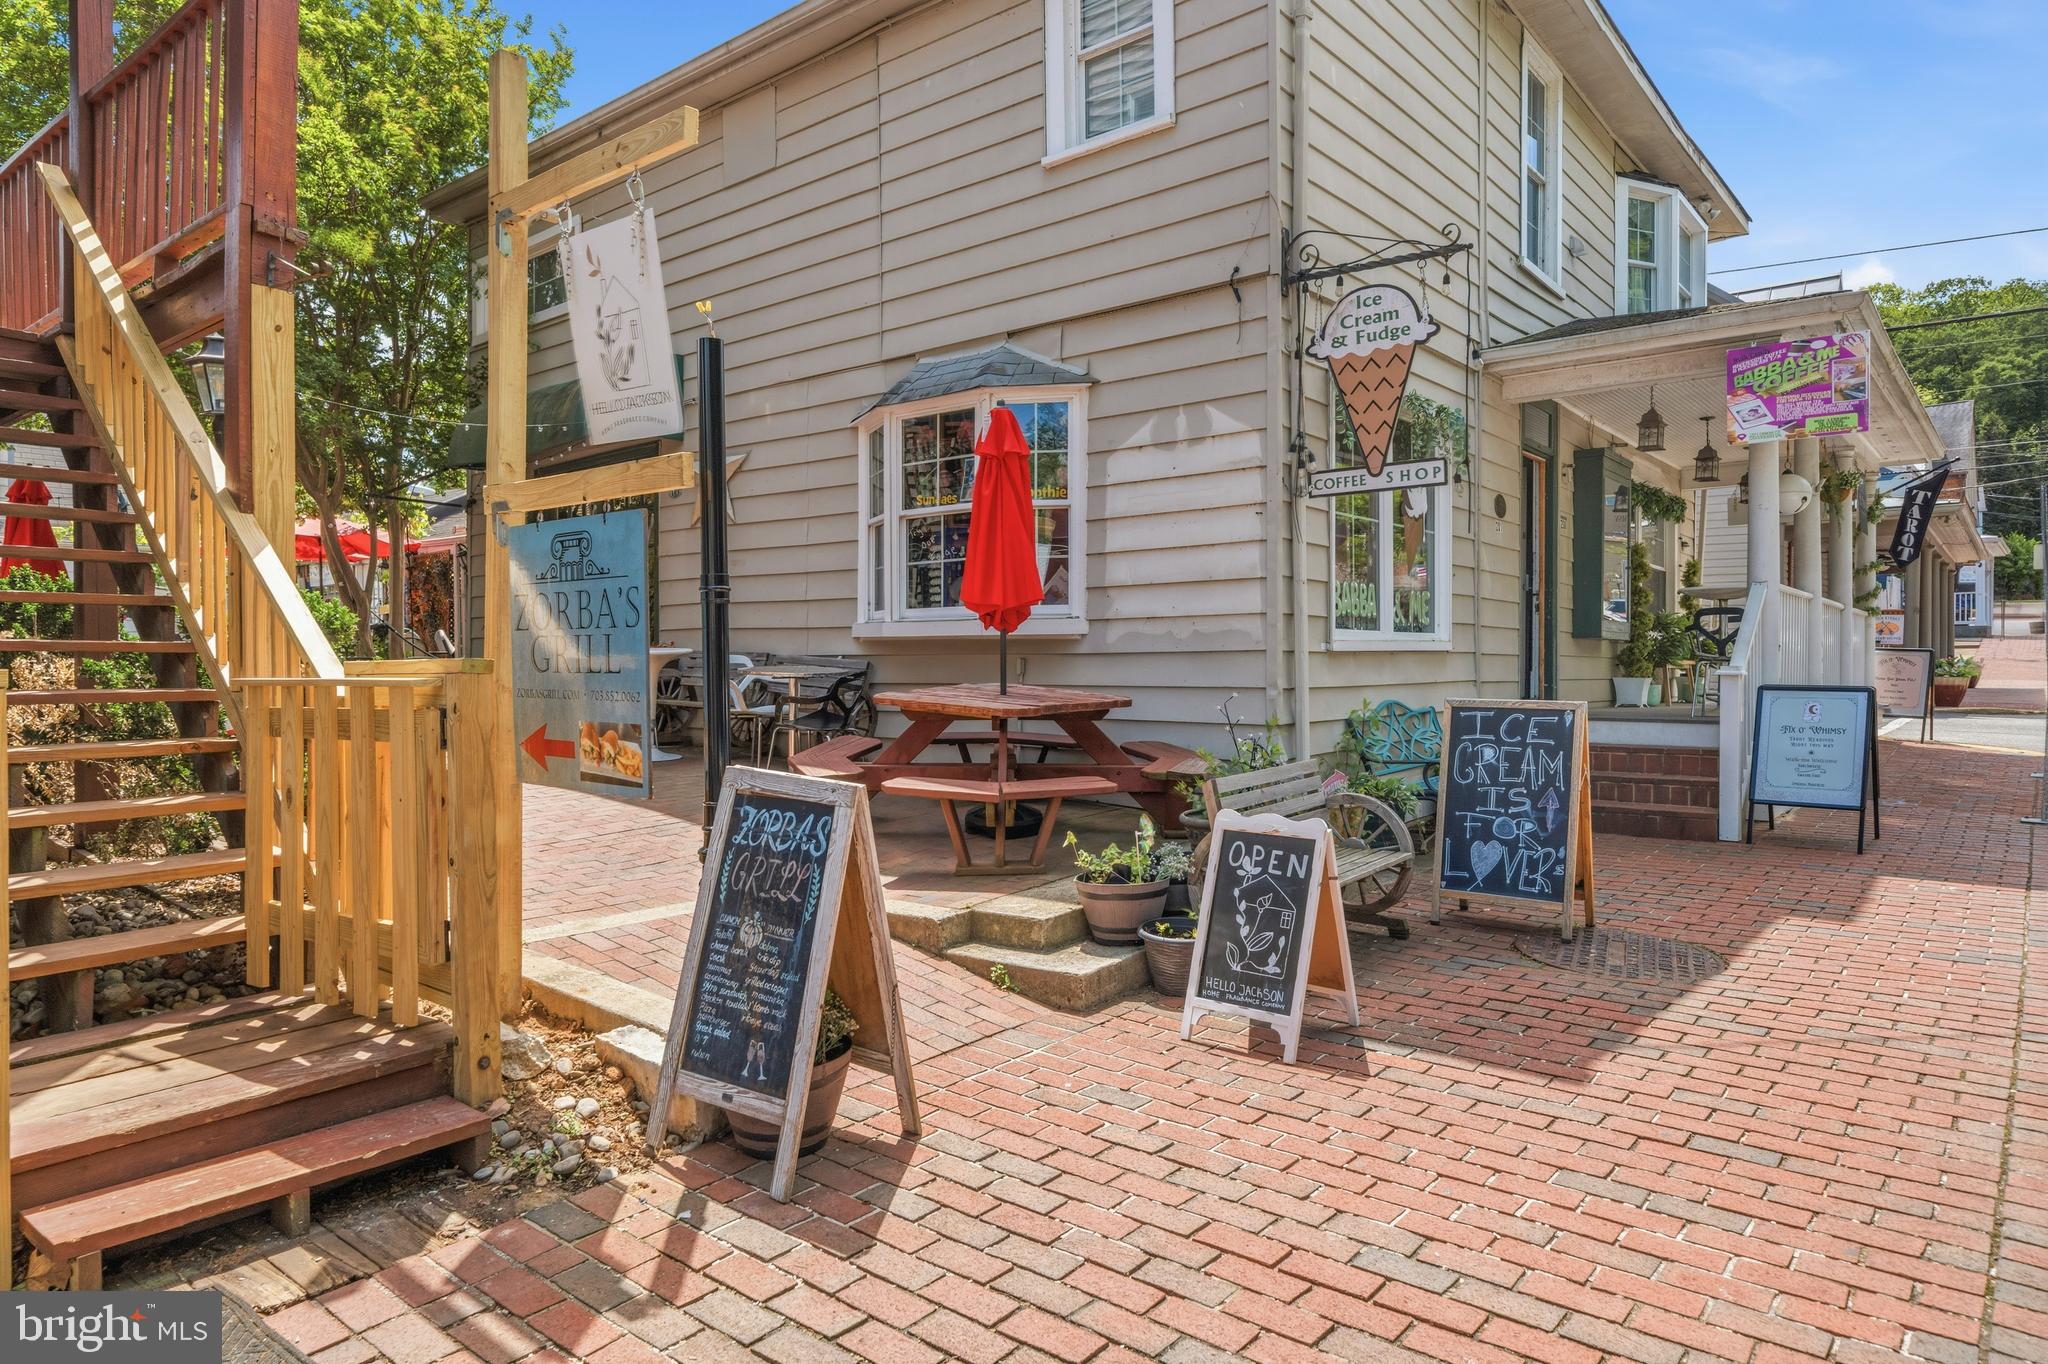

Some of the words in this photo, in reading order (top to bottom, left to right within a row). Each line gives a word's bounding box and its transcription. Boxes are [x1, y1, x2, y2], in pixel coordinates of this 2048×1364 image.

[1340, 308, 1400, 329] Cream
[1356, 294, 1382, 309] Ice
[1331, 335, 1348, 349] &
[1356, 324, 1411, 346] Fudge
[1314, 474, 1367, 491] COFFEE
[1386, 466, 1442, 484] SHOP
[1897, 489, 1932, 562] TAROT
[515, 585, 641, 632] ZORBA'S
[531, 633, 622, 674] GRILL
[1459, 711, 1559, 745] ICE
[1453, 741, 1565, 791] CREAM
[1476, 787, 1531, 814] IS
[1455, 812, 1541, 850] FOR
[1229, 841, 1309, 879] OPEN
[1206, 976, 1236, 993] HELLO
[1239, 984, 1285, 1004] JACKSON
